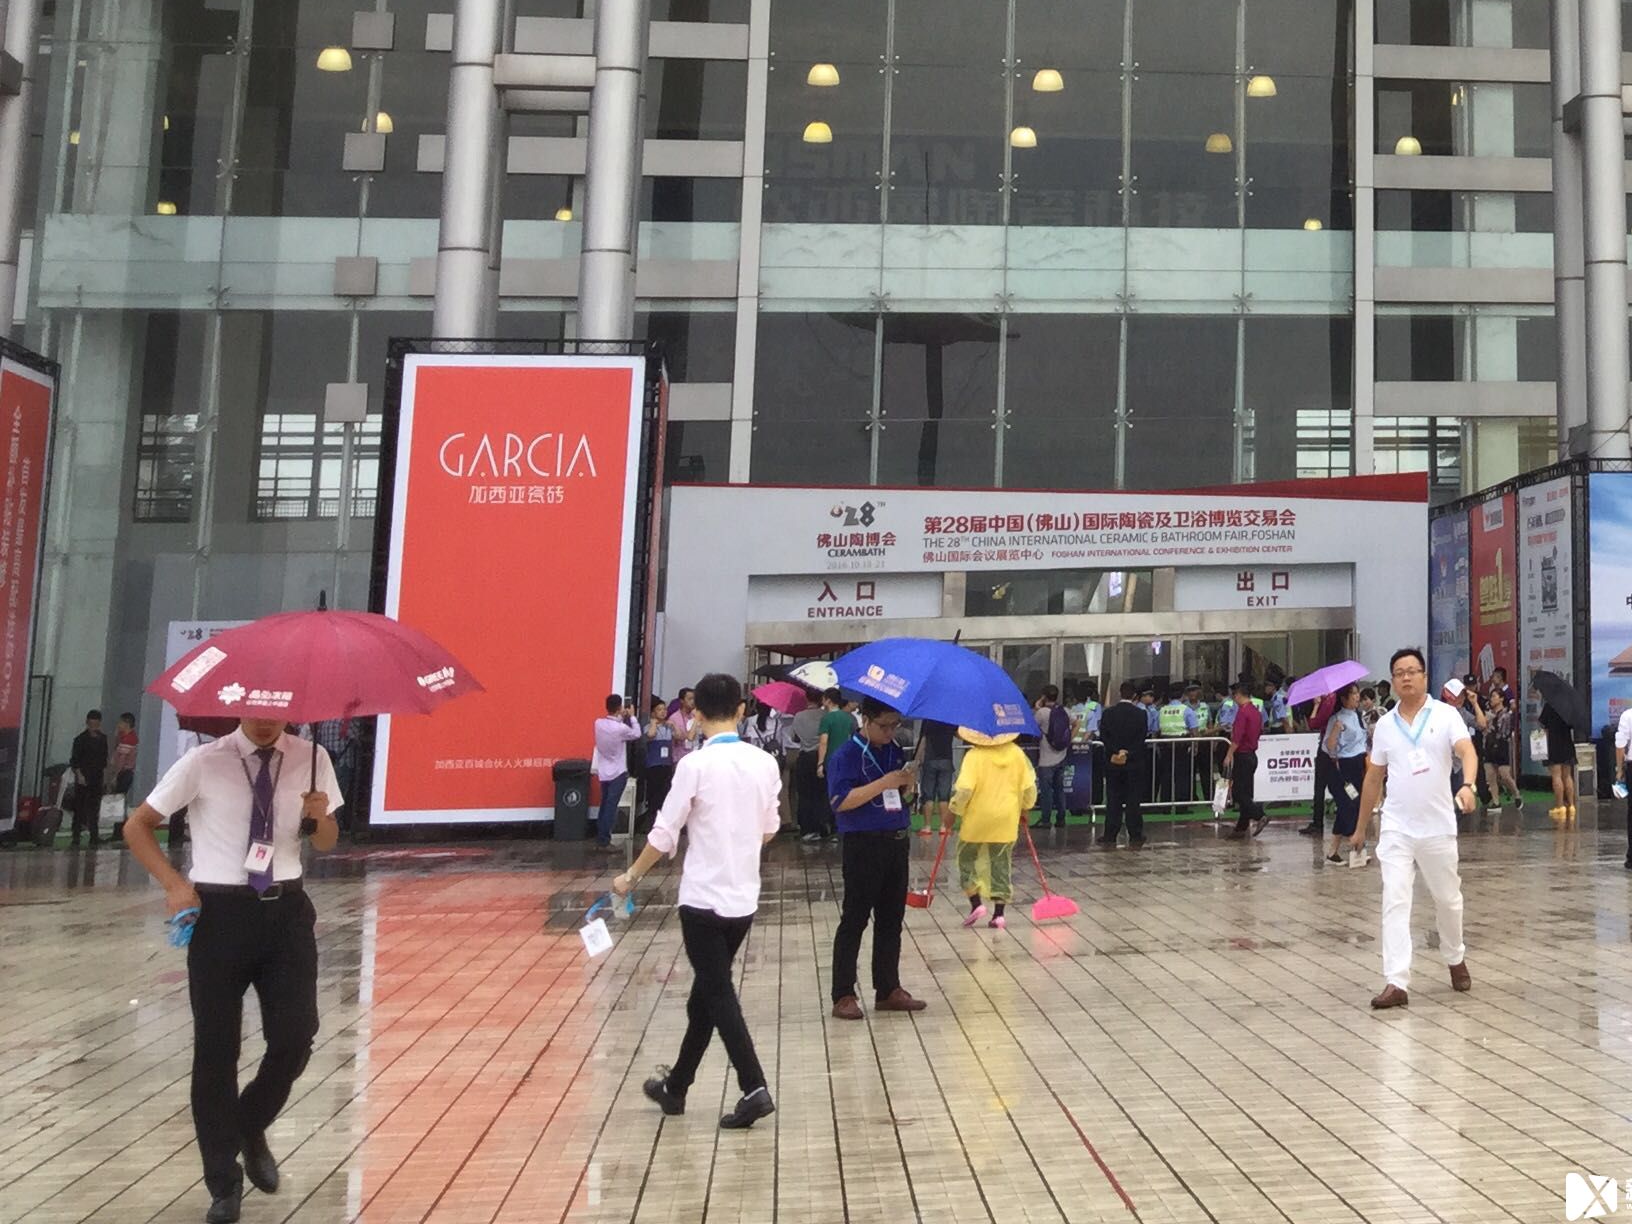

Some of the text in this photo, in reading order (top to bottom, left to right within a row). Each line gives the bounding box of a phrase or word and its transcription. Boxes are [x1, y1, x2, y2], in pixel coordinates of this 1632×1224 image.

[439, 432, 598, 478] GARCIA
[468, 485, 565, 504] 加西亚瓷砖
[816, 531, 897, 548] 佛山陶博会
[923, 537, 945, 549] THE
[971, 536, 1006, 548] CHINA
[1008, 533, 1097, 546] INTERNATIONAL
[1099, 531, 1149, 544] CERAMIC
[1151, 531, 1158, 543] &
[1161, 530, 1223, 543] BATHROOM
[827, 548, 886, 557] CERAMBATH
[922, 548, 1044, 563] 佛山国际会议展览中心
[1051, 545, 1293, 559] FOSHAN INTERNATIONAL CONFERENCE & EXHIBITION CENTER
[1236, 571, 1290, 591] 出口
[817, 580, 875, 602] 入口
[1247, 595, 1279, 607] EXIT
[807, 605, 884, 618] ENTRANCE
